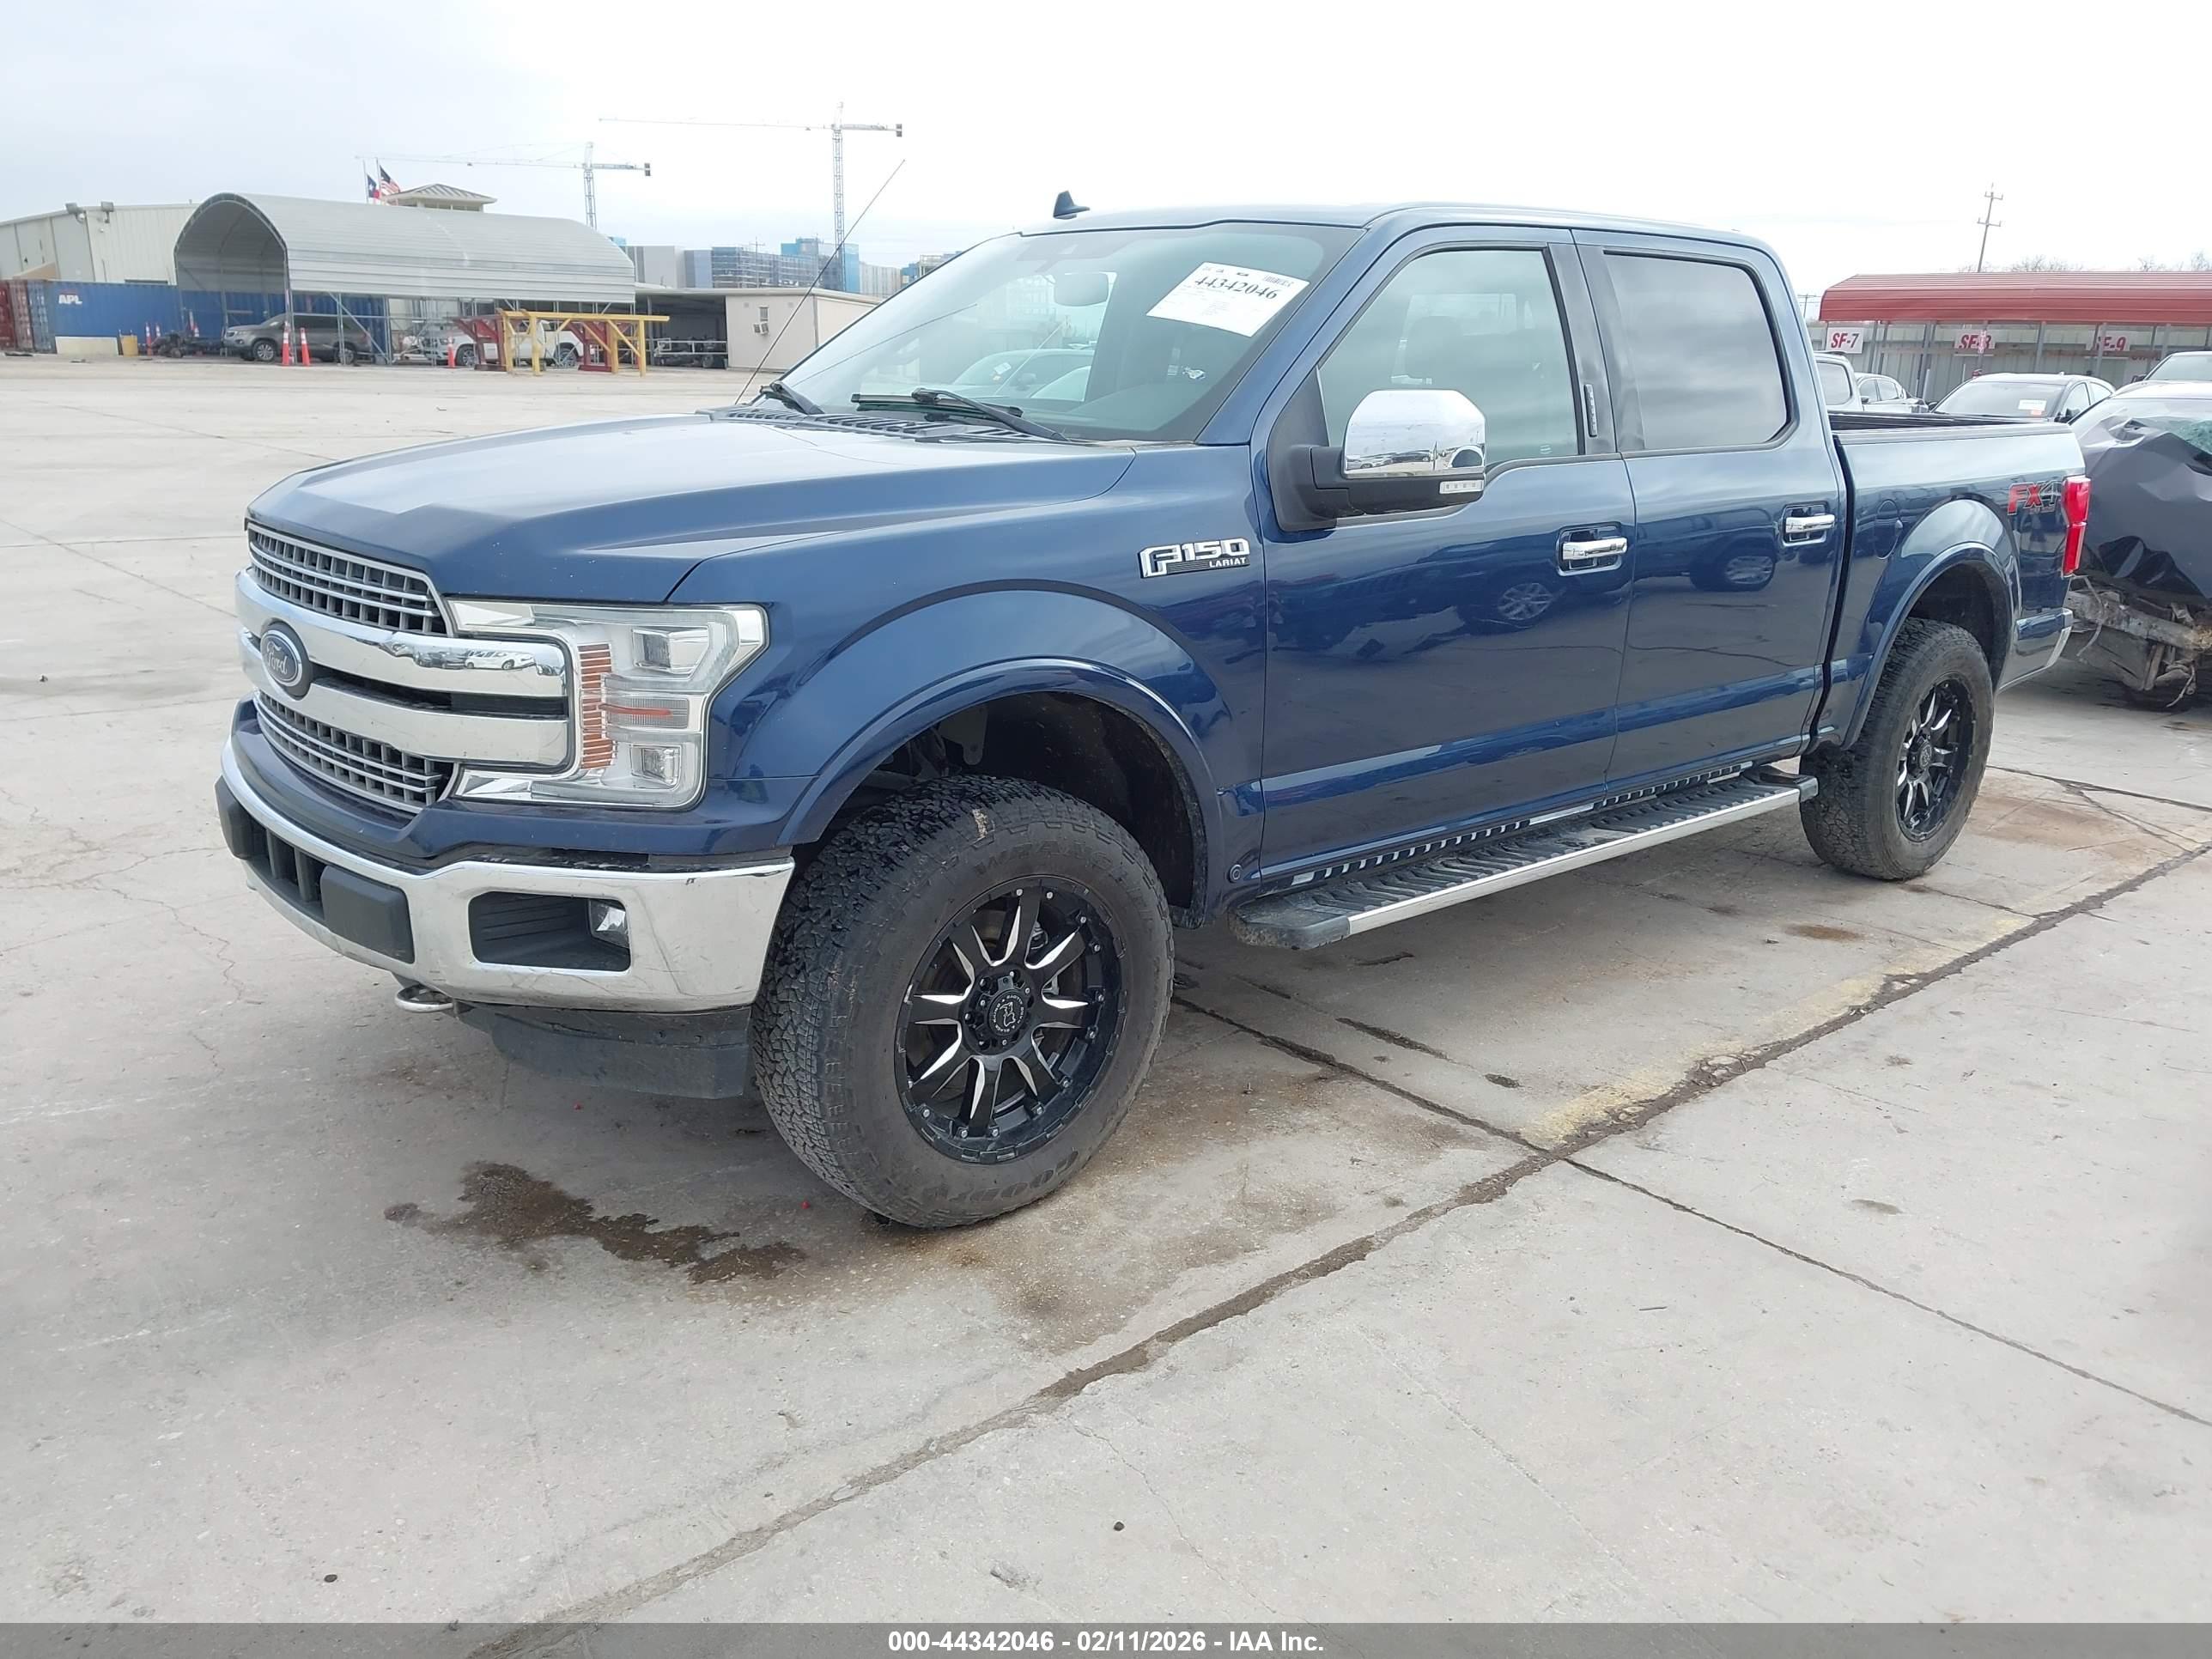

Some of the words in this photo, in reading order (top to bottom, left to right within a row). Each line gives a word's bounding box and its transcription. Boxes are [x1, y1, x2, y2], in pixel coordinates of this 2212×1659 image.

[1194, 276, 1278, 300] 44342046
[58, 295, 82, 305] APL
[1831, 332, 1860, 349] SF-7
[2007, 480, 2061, 515] FX4
[1209, 556, 1247, 568] LARIAT
[266, 641, 289, 675] Ford
